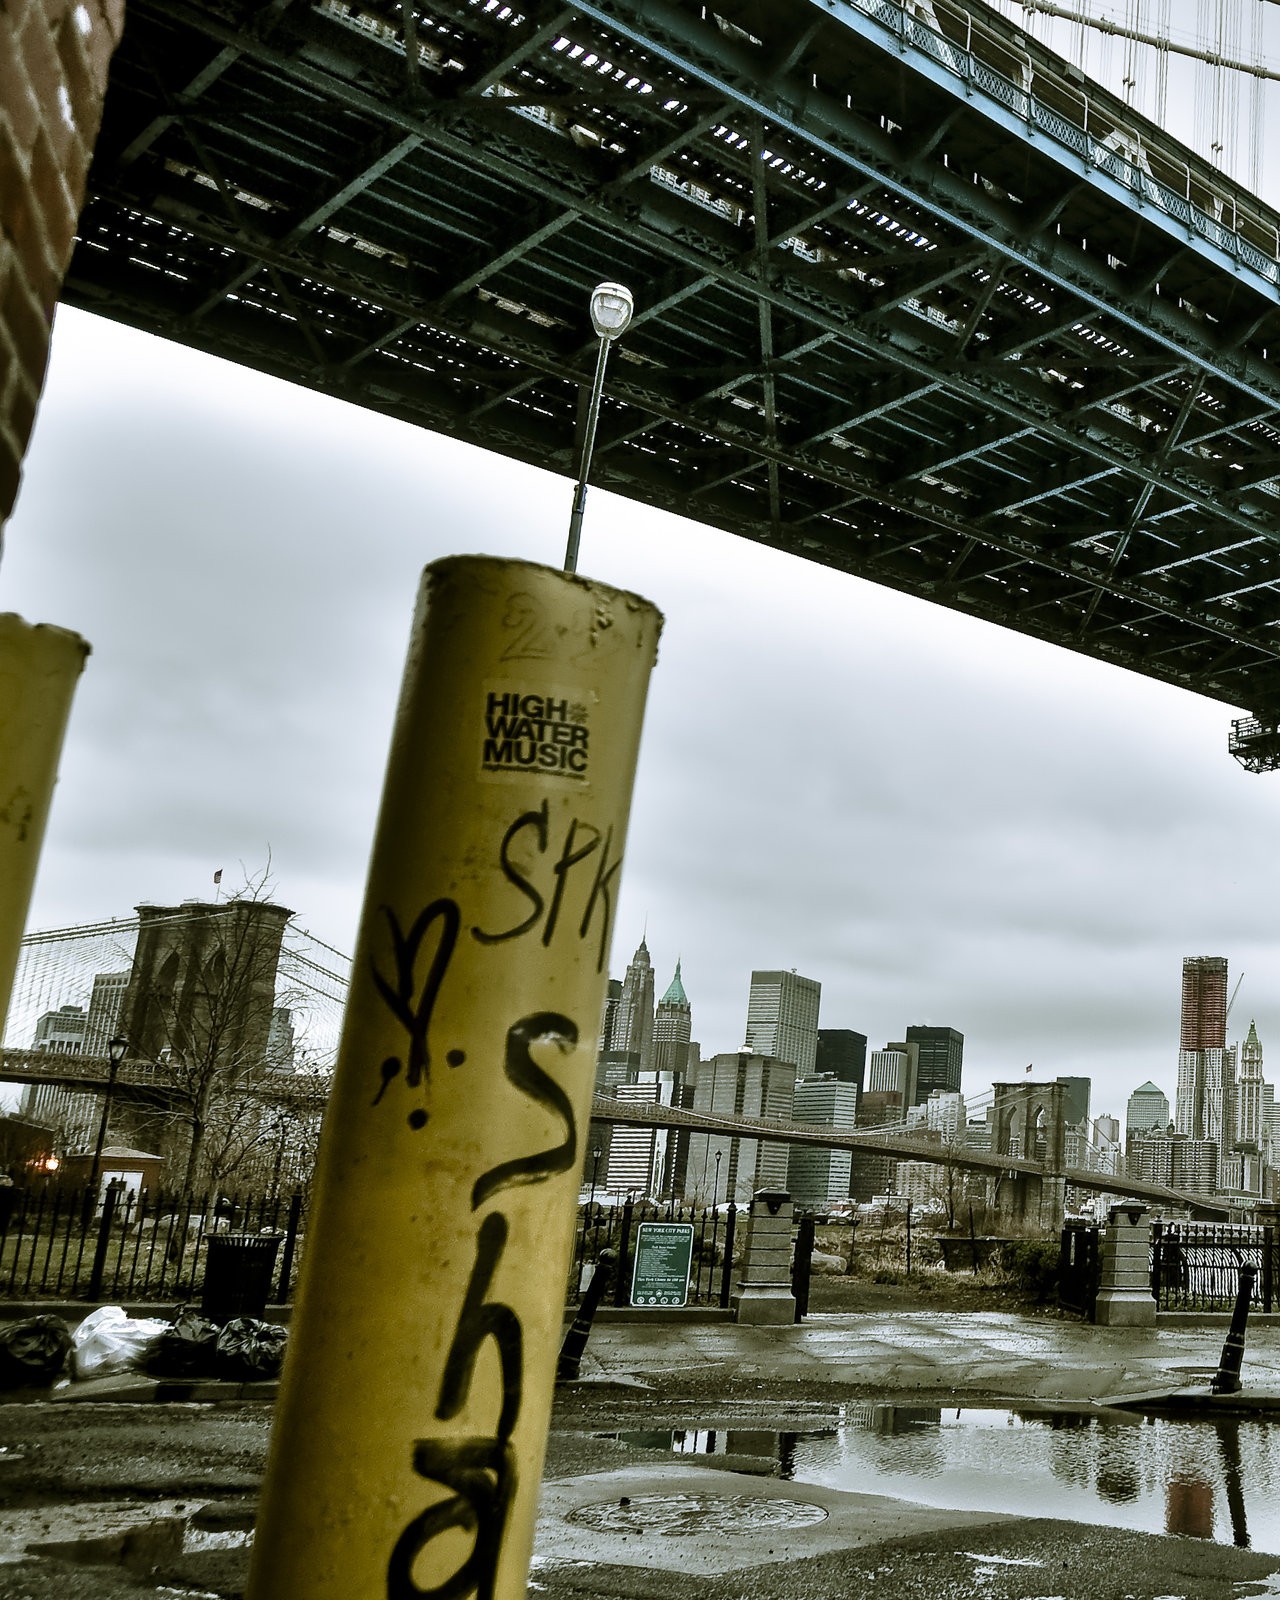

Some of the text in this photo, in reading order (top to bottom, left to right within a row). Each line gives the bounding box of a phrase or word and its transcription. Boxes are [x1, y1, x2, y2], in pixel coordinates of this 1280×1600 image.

[487, 692, 569, 722] HIGH
[485, 715, 590, 749] WATER
[483, 739, 589, 772] MUSIC
